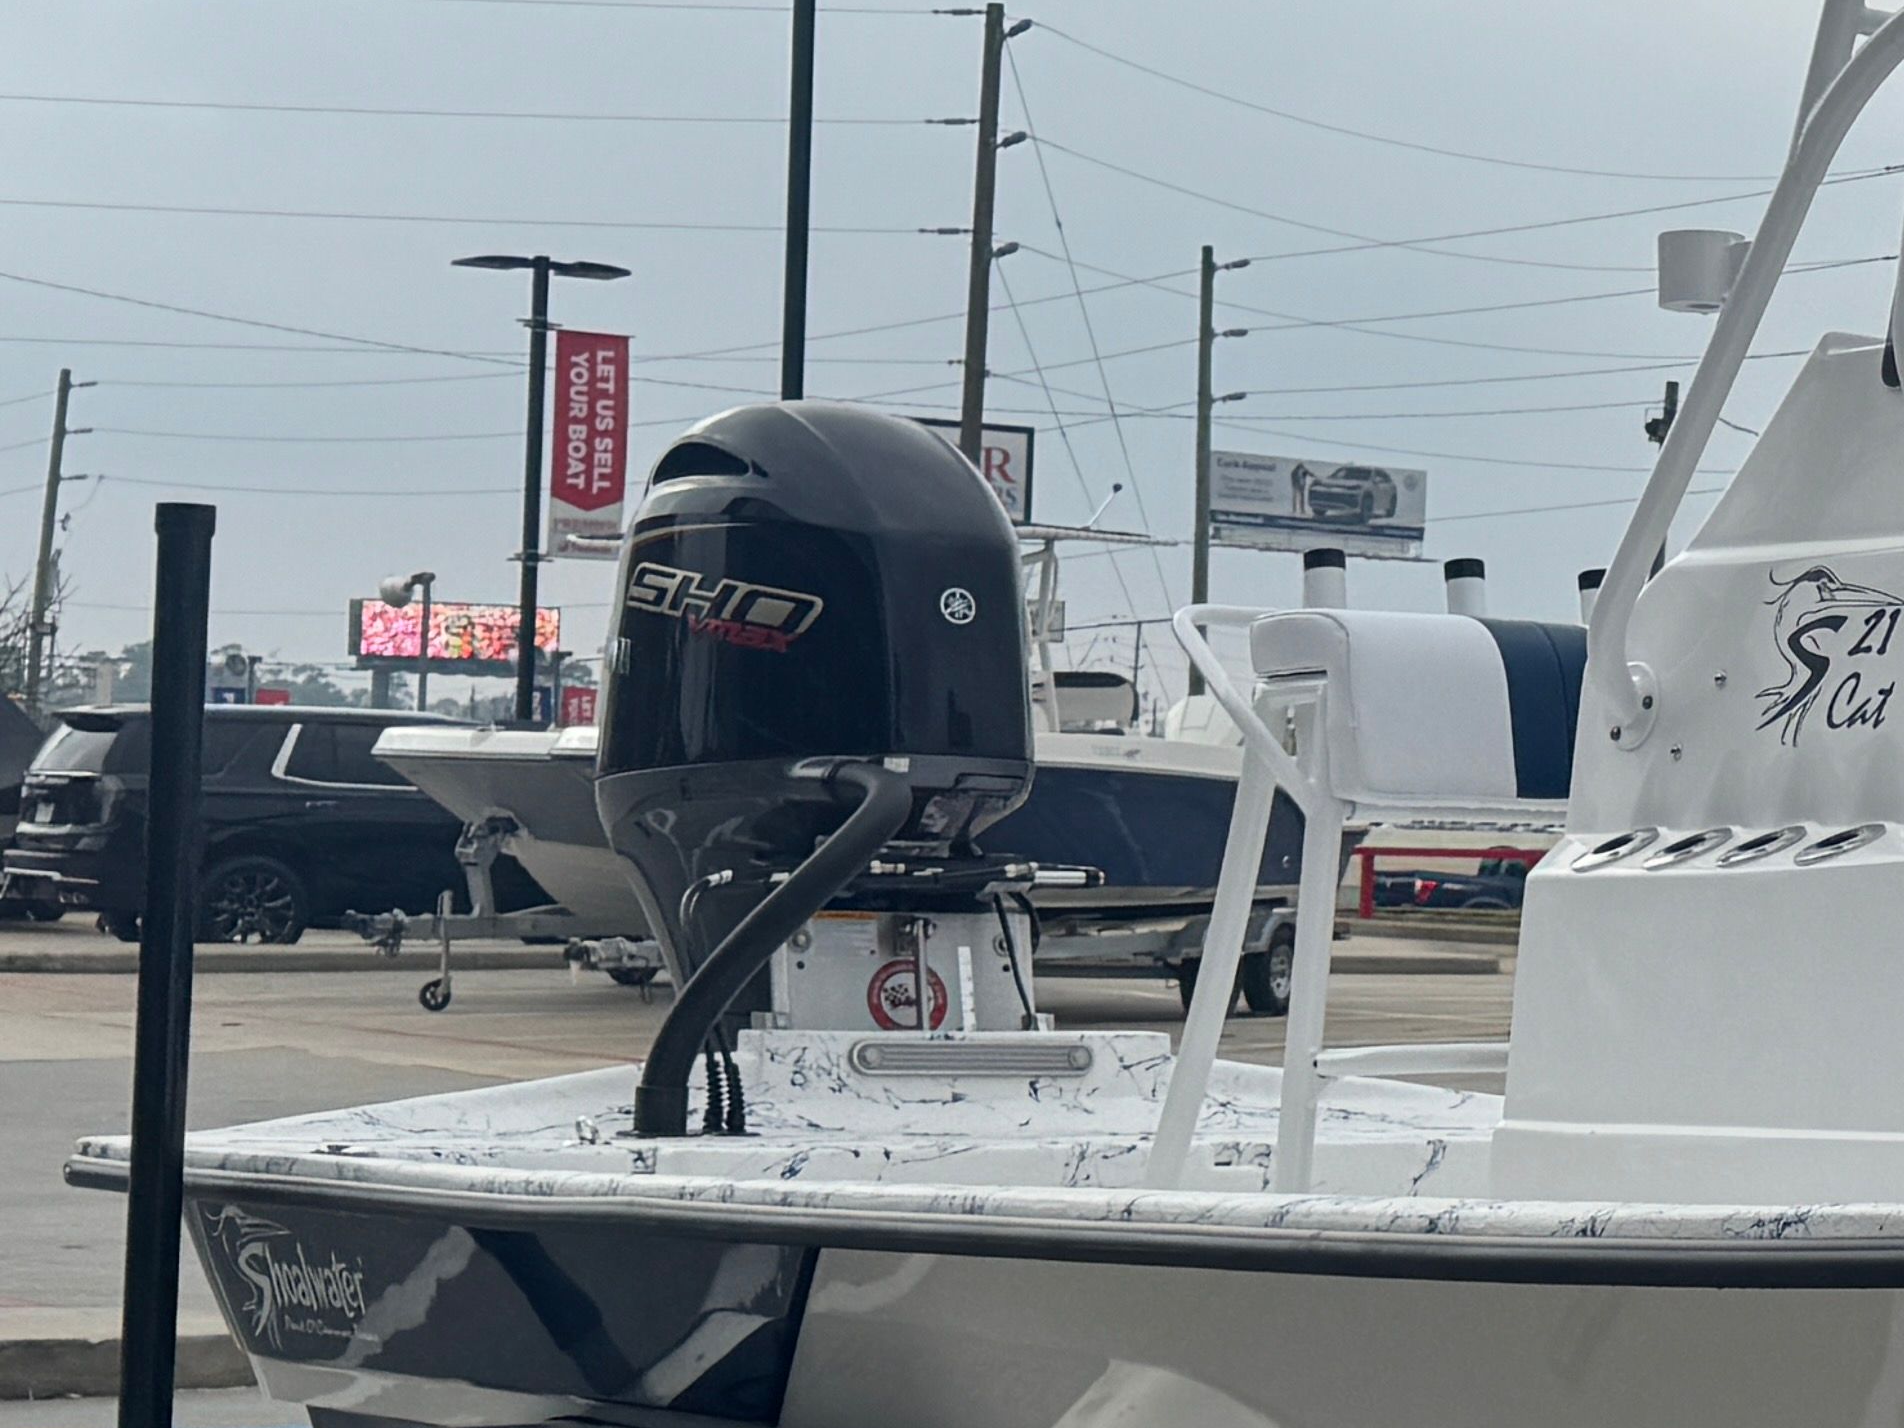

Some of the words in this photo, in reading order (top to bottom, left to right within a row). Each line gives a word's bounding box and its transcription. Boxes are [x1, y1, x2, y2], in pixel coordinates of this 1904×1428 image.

[568, 352, 590, 419] YOUR
[596, 350, 616, 394] LET
[595, 400, 616, 431] US
[566, 425, 588, 490] BOAT
[592, 437, 613, 495] SELL
[626, 561, 824, 640] SHO
[1848, 608, 1901, 657] 21
[1827, 671, 1896, 730] Cat
[238, 1241, 367, 1337] Shoalwater
